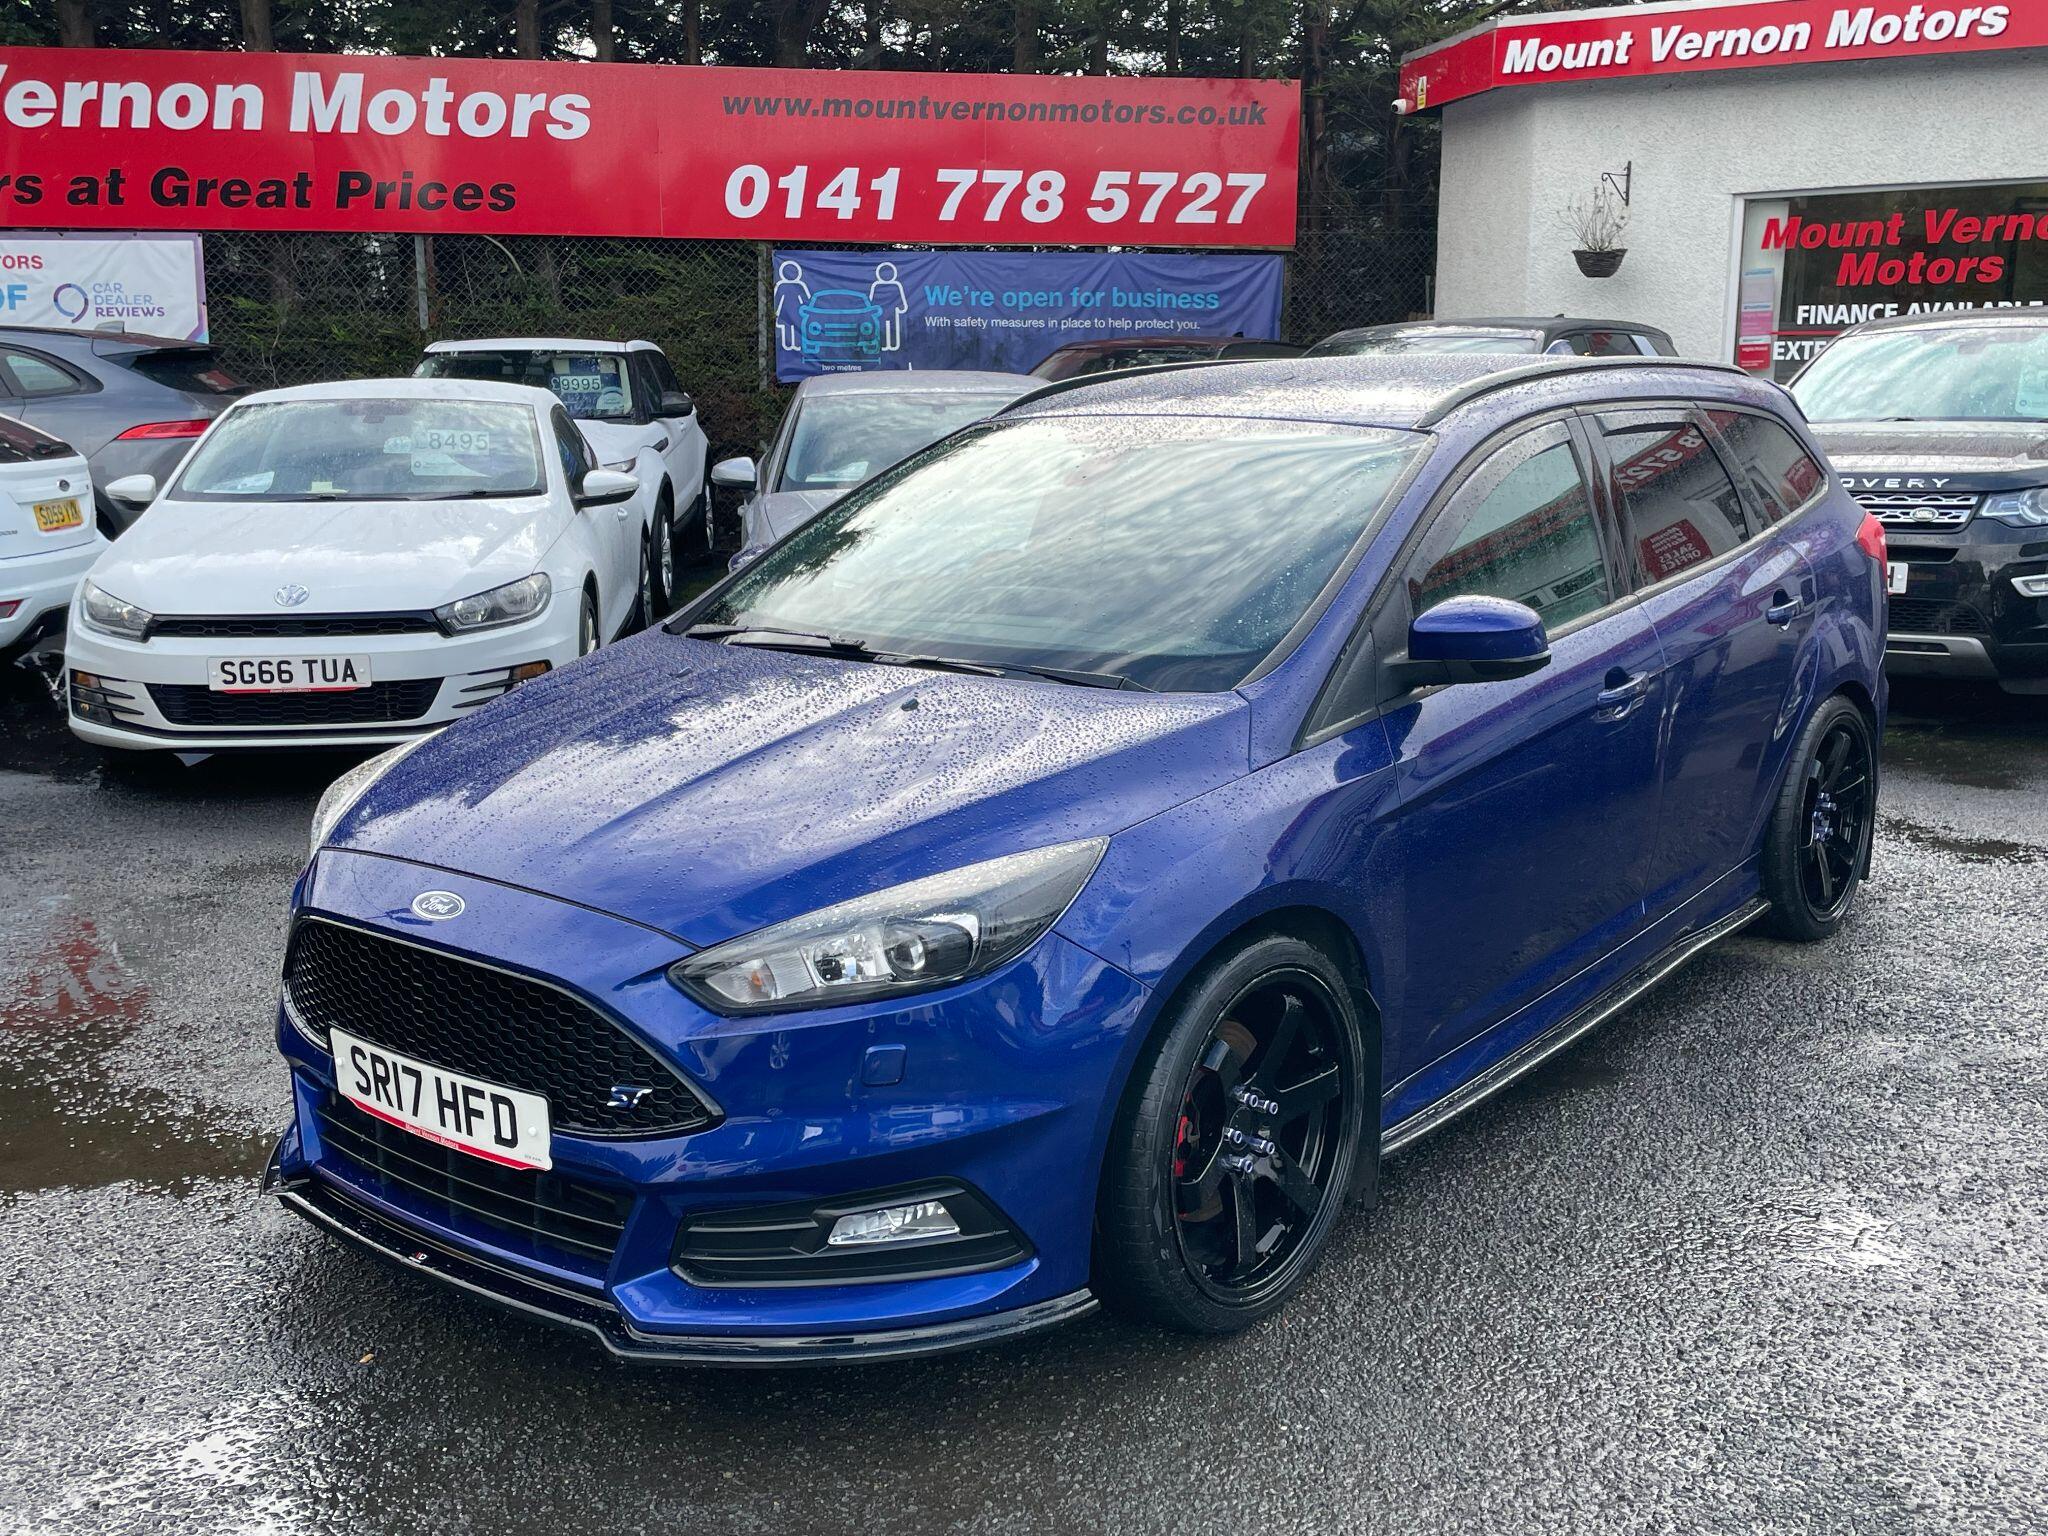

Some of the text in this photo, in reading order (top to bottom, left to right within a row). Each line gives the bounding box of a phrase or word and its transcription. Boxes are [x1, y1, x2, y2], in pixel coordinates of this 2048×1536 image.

[1502, 5, 2010, 74] Mount Vernon Motors
[289, 72, 591, 140] Motors
[722, 96, 1267, 125] www.mountvernonmotors.co.uk
[67, 168, 126, 206] at
[151, 167, 313, 208] Great
[335, 171, 516, 212] Prices
[724, 164, 1267, 224] 0141 778 5727
[1761, 213, 1905, 250] Mount
[0, 255, 43, 269] ORS
[1836, 252, 2004, 286] Motors
[93, 283, 123, 293] CAR
[95, 295, 153, 305] DEALER
[1002, 290, 1063, 311] open
[1070, 286, 1105, 307] for
[1112, 286, 1220, 309] business
[95, 307, 165, 317] REVIEWS
[924, 317, 1200, 332] With safety measures in place to help protect you.
[1797, 303, 1898, 325] FINANCE
[551, 376, 600, 391] £9995
[220, 659, 358, 685] SG66 TUA
[351, 1045, 519, 1149] SR17 HFD
